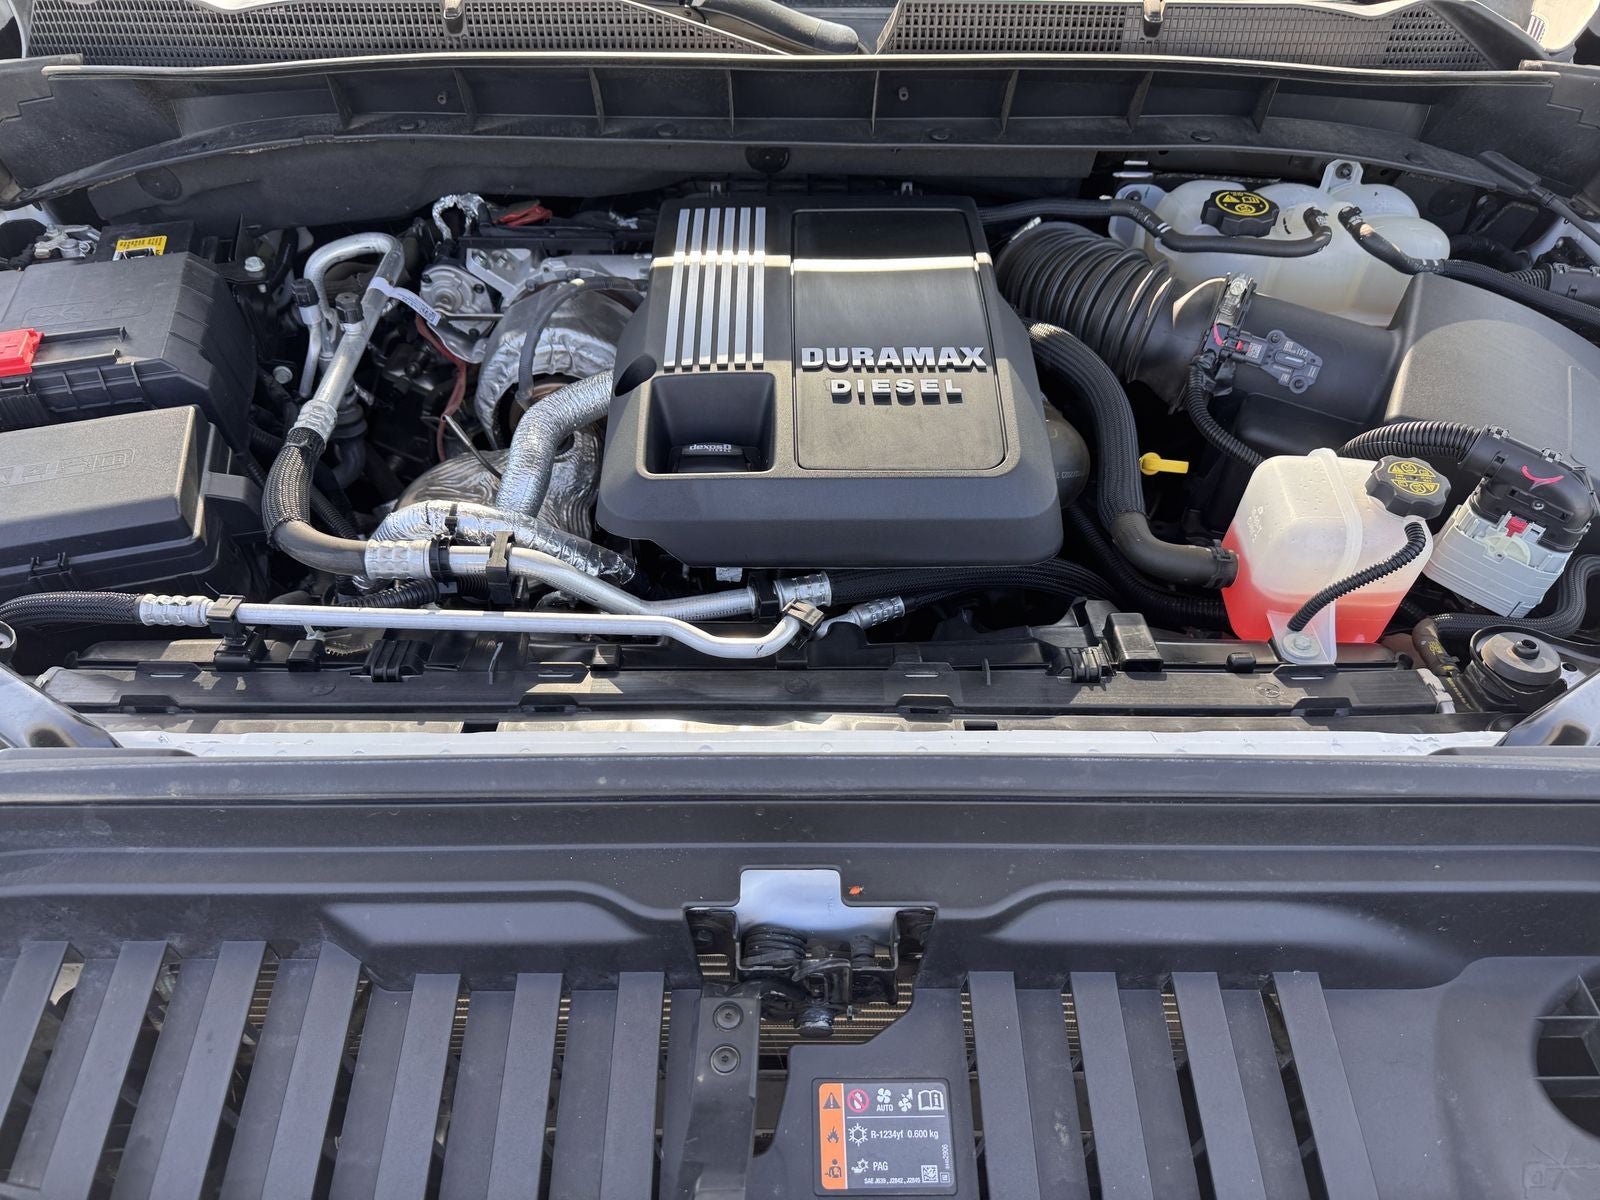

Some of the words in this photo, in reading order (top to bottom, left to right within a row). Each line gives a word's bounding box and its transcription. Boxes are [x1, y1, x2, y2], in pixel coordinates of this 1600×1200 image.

[801, 346, 987, 368] DURAMAX
[831, 379, 962, 394] DIESEL
[876, 1104, 894, 1112] AUTO
[870, 1130, 904, 1140] R-1234yf
[907, 1130, 928, 1138] 0.600
[929, 1130, 939, 1140] kg
[873, 1161, 889, 1171] PAG
